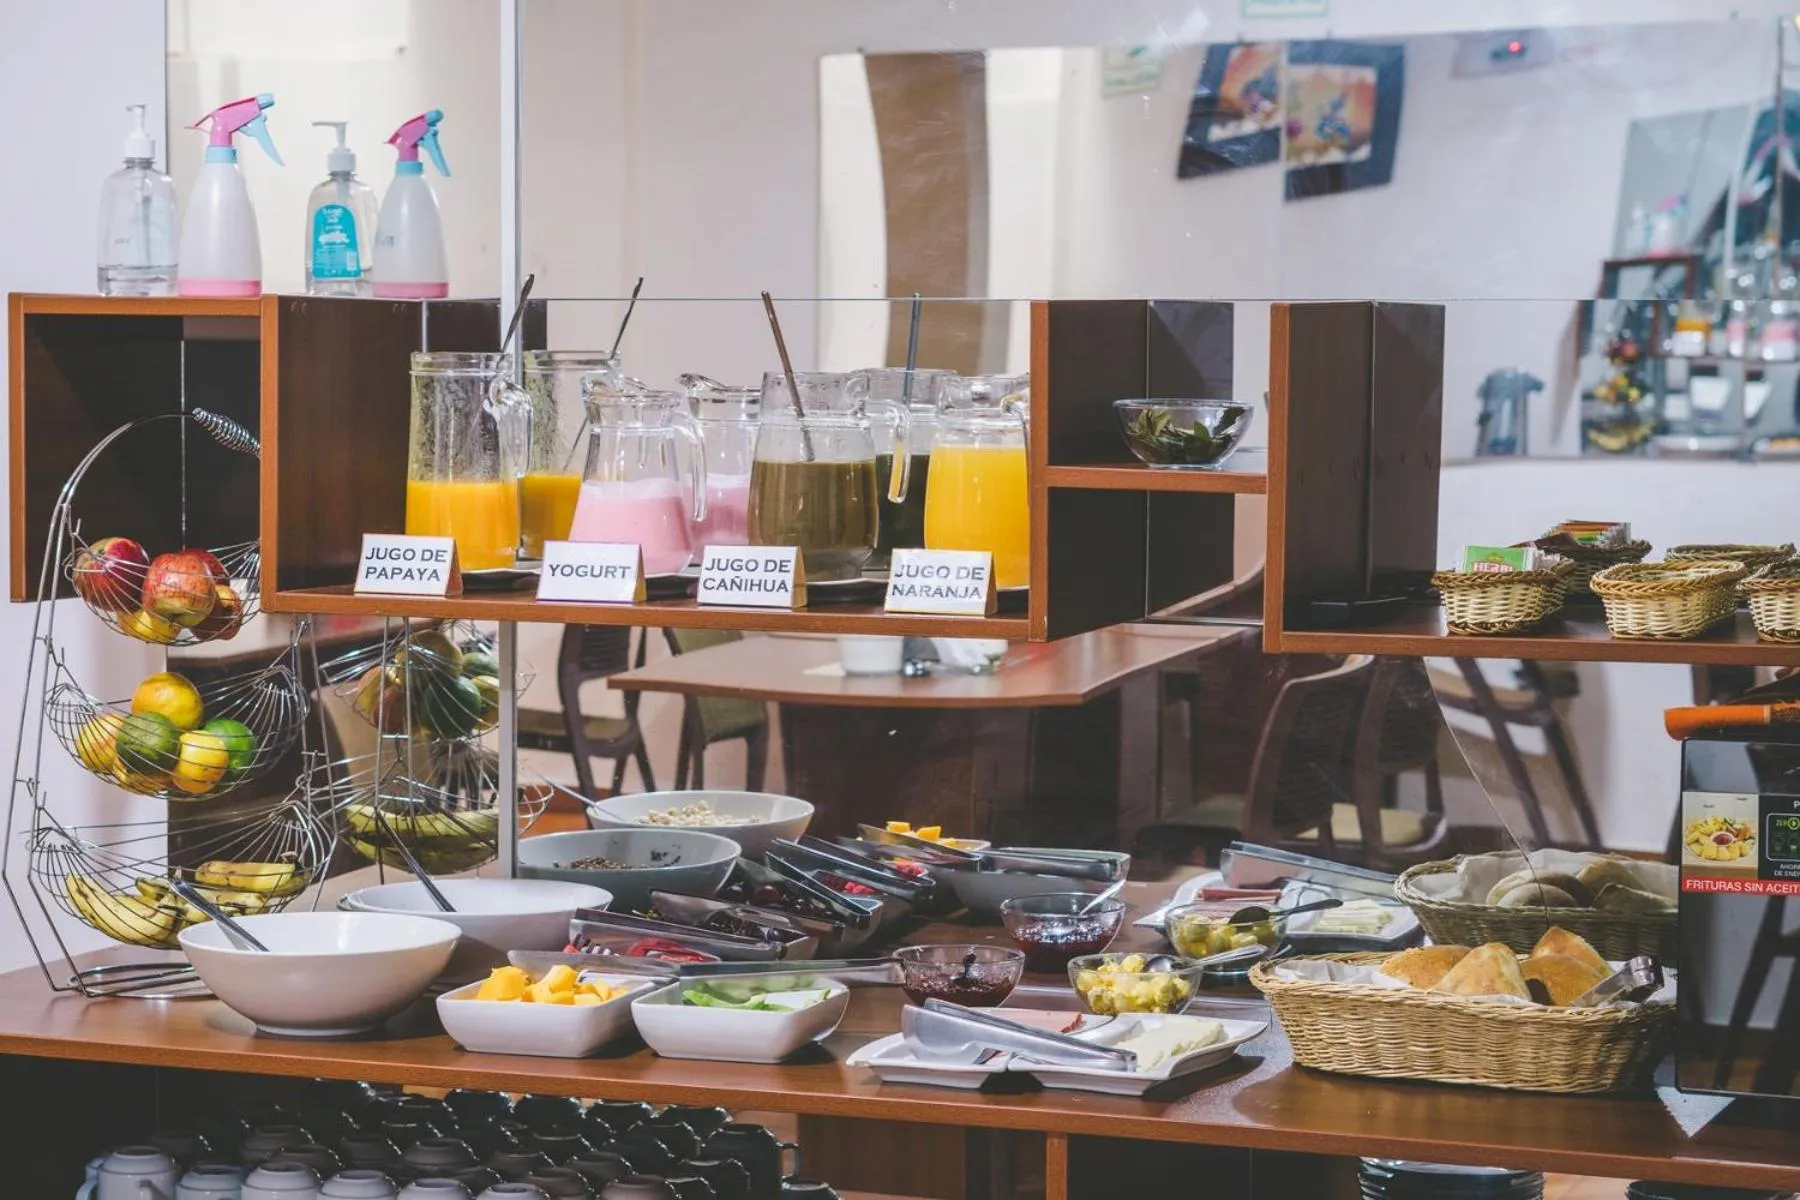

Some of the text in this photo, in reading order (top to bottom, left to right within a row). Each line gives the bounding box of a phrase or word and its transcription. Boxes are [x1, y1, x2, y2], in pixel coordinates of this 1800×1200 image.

[365, 547, 448, 563] JUGO DE
[549, 563, 631, 580] YOGURT
[705, 557, 791, 573] JUGO DE
[895, 564, 984, 581] JUGO DE
[365, 566, 441, 582] PAPAYA
[703, 576, 789, 593] CAÑIHUA
[892, 583, 982, 599] NARANJA
[1686, 880, 1800, 894] FRITURAS SIN ACEIT
